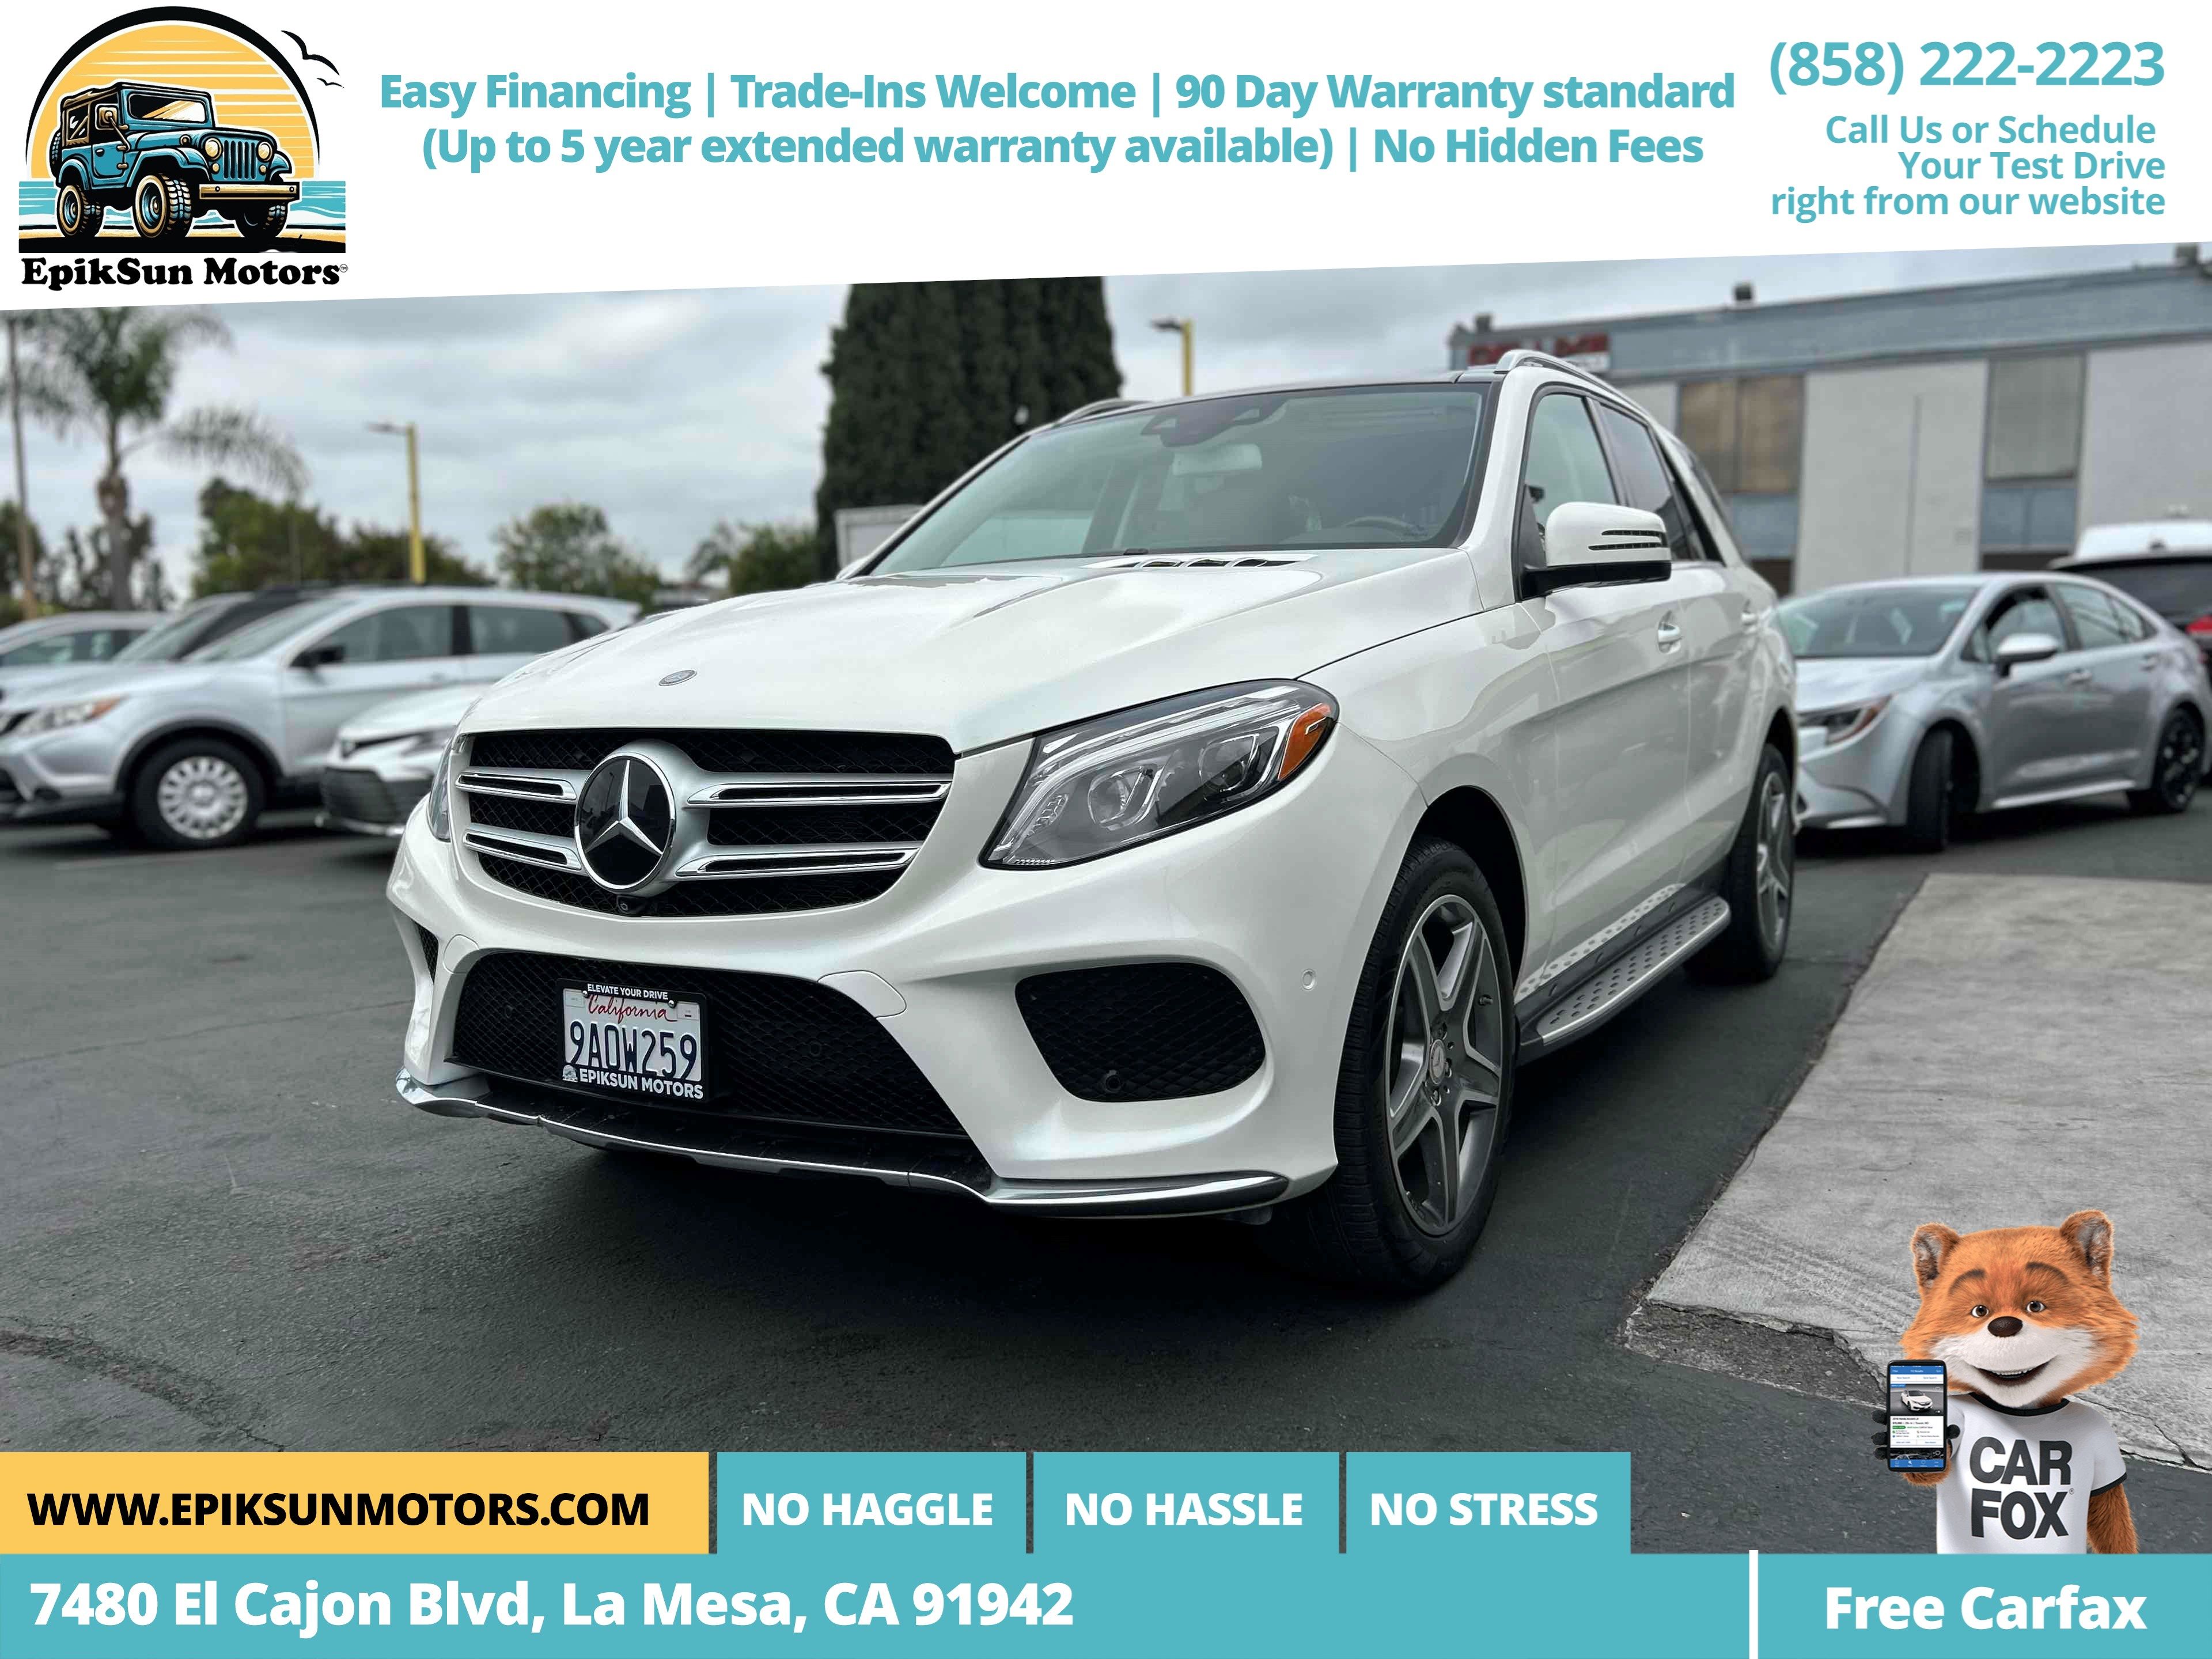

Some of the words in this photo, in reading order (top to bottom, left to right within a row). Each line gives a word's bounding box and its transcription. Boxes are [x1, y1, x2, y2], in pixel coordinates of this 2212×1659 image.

[588, 984, 618, 995] ELEVATE
[620, 987, 642, 997] YOUR
[643, 990, 668, 999] DRIVE
[588, 994, 678, 1024] California
[570, 1021, 697, 1080] 9AOW259
[579, 1069, 638, 1090] EPIKSUN
[642, 1077, 703, 1100] MOTORS
